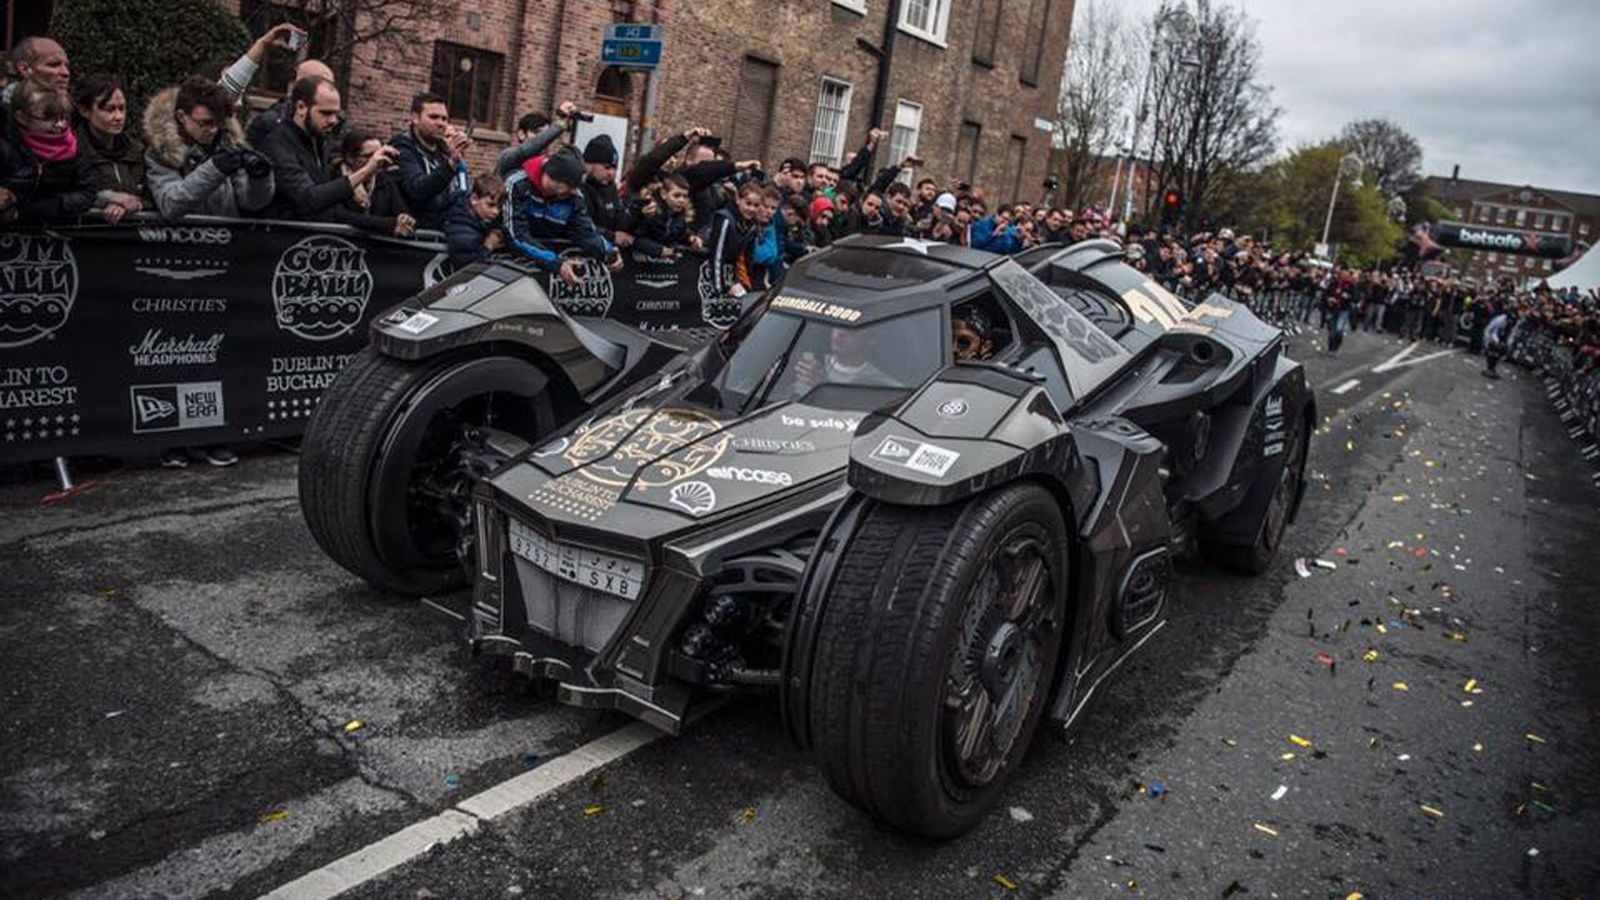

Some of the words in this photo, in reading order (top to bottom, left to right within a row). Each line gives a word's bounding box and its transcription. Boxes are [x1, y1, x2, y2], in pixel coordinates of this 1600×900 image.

[1459, 227, 1522, 249] betsafe
[281, 272, 367, 299] BALL
[132, 297, 227, 312] CHRISTIE'S
[769, 295, 827, 313] GUMBALL
[824, 304, 862, 322] 3000
[129, 327, 225, 354] Marshall
[134, 353, 217, 366] HEADPHONES
[272, 356, 335, 374] DUBLIN
[35, 365, 68, 384] TO
[266, 372, 338, 393] BUCHAR
[184, 391, 218, 405] NEW
[186, 404, 218, 419] ERA
[588, 570, 630, 596] SXB
